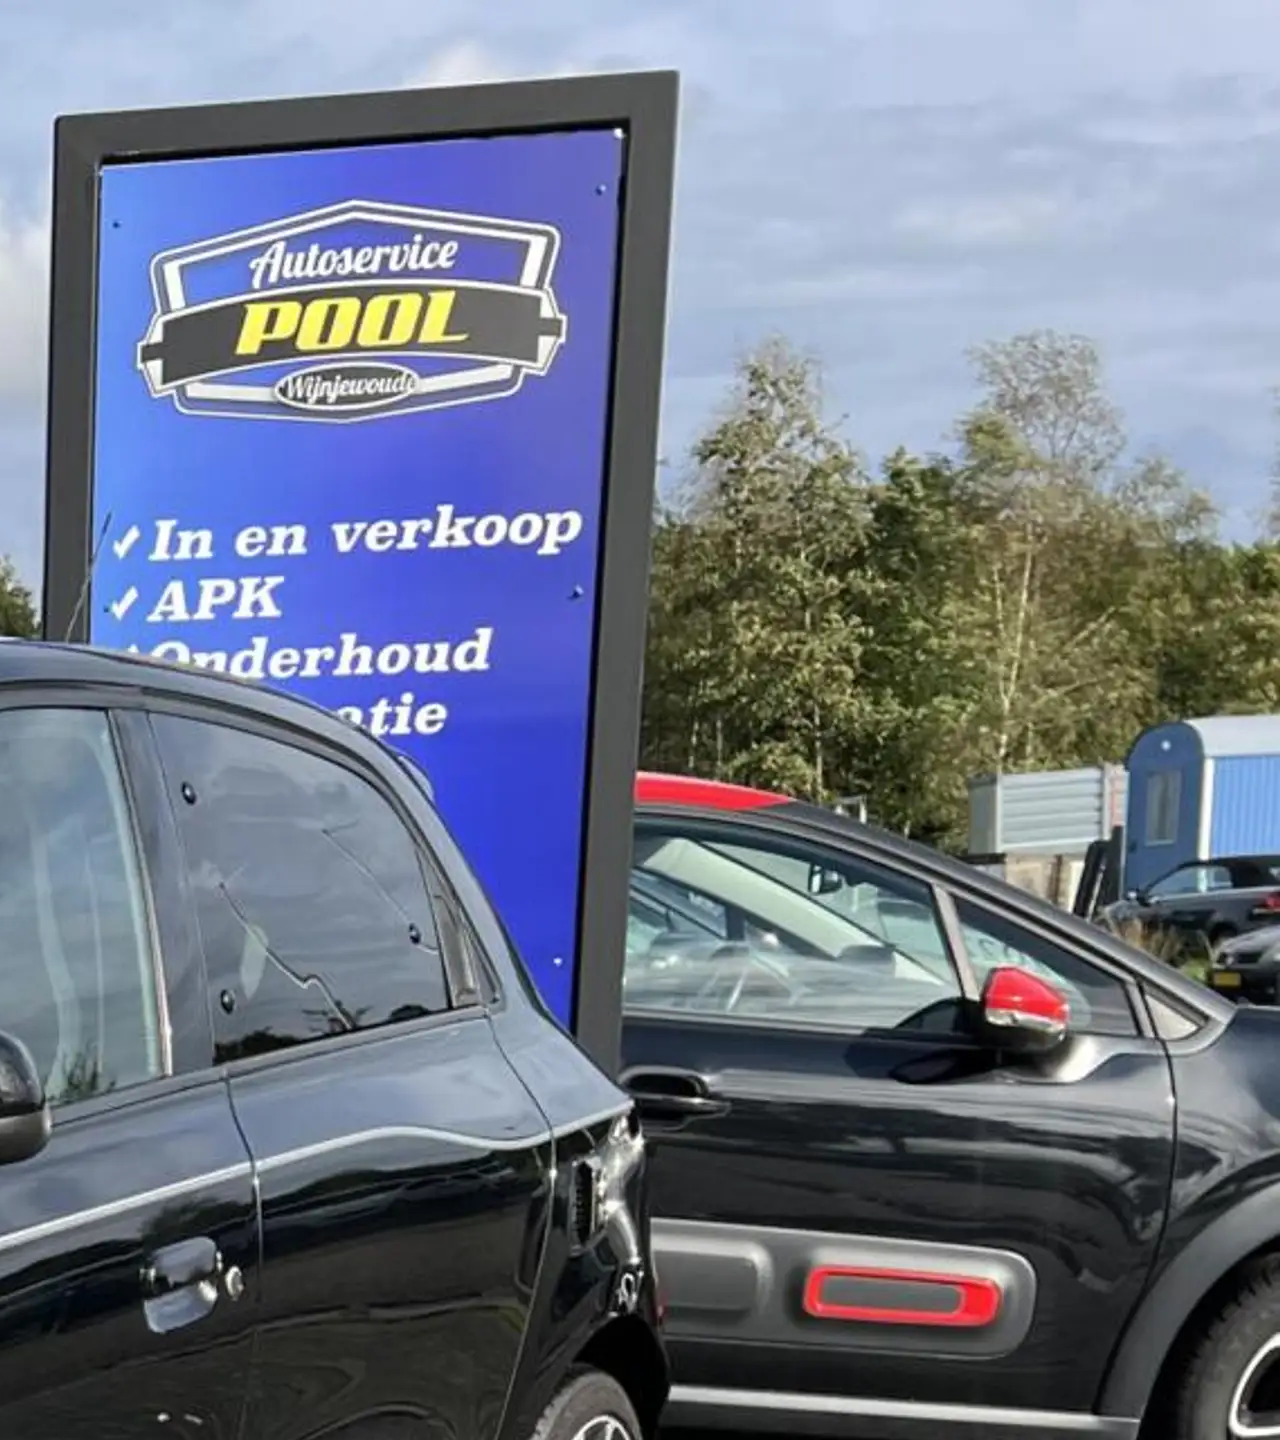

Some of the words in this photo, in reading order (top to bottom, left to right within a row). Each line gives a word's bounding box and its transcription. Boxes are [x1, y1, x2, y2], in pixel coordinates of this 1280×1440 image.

[249, 234, 458, 289] Autoservice
[235, 290, 469, 355] POOL
[148, 519, 213, 563] In
[234, 525, 306, 557] en
[332, 505, 583, 556] verkoop
[146, 577, 285, 621] APK
[337, 691, 448, 736] atie
